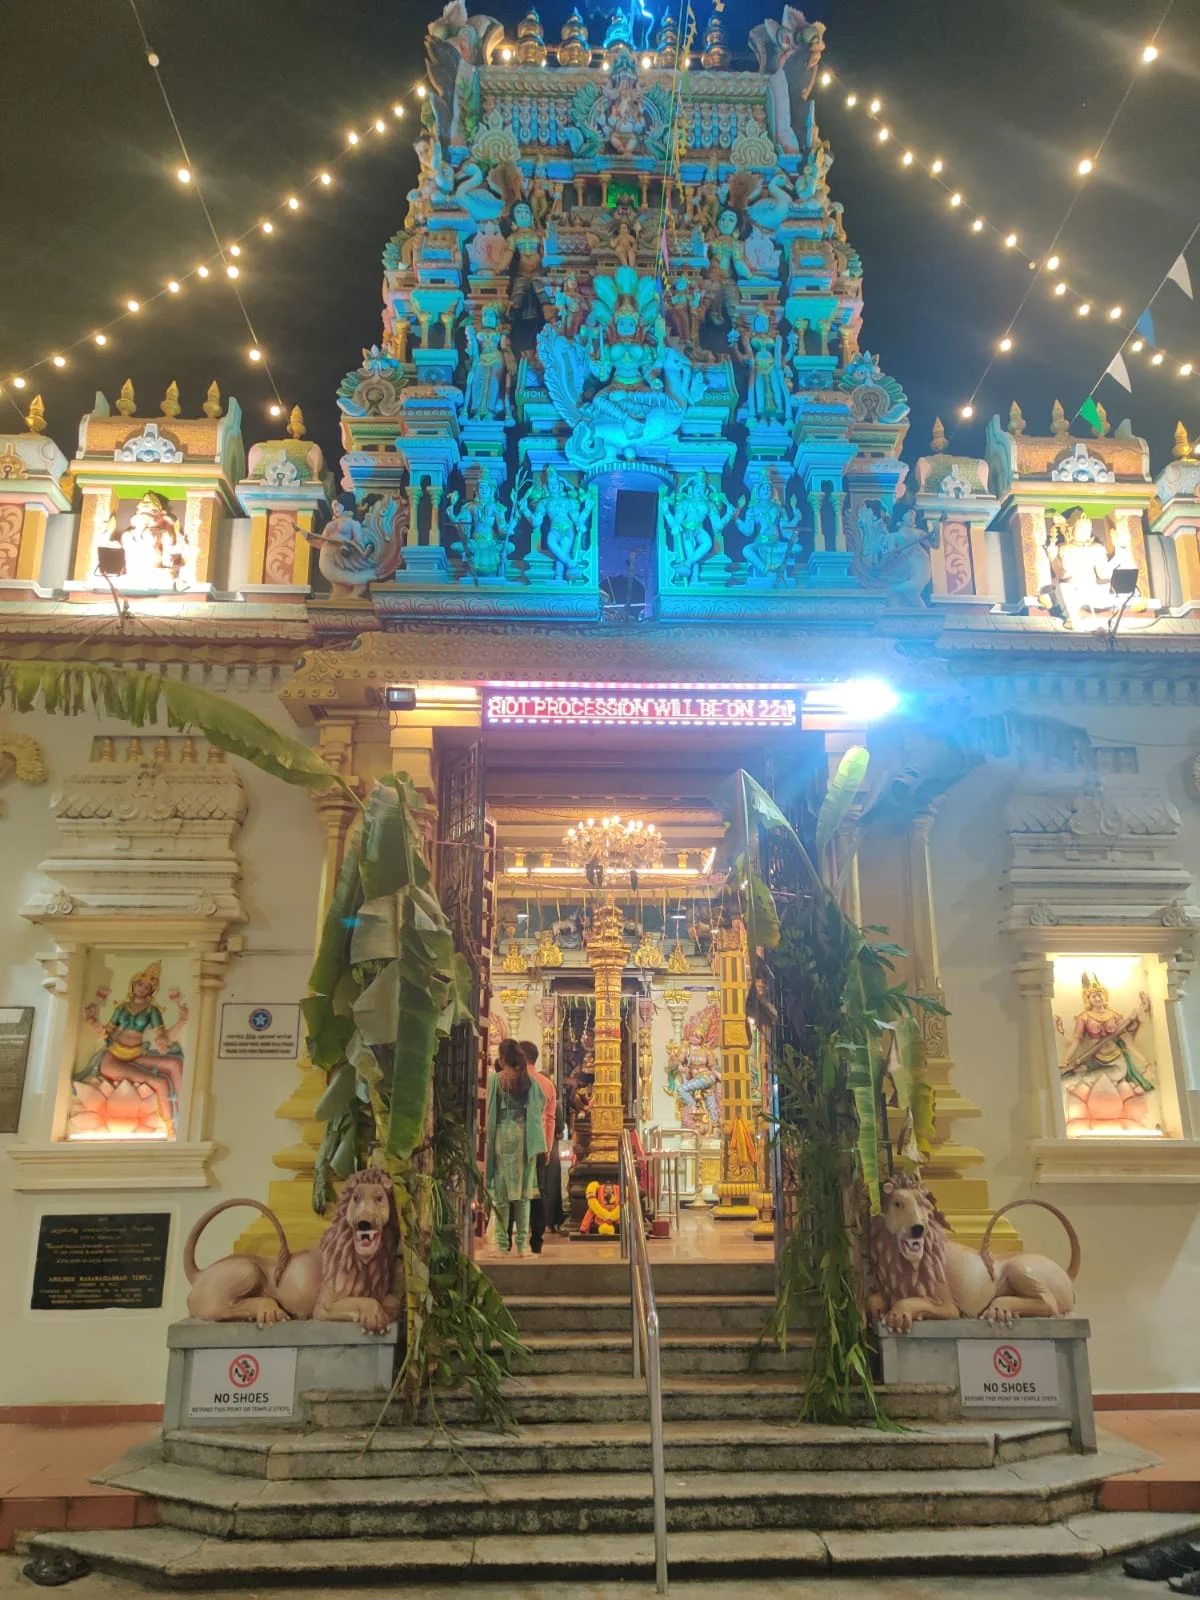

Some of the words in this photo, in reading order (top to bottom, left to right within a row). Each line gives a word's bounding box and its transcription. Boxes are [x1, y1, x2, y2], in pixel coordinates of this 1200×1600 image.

[534, 700, 648, 716] PROCESSION
[654, 701, 698, 717] WILL
[701, 702, 722, 717] BE
[727, 702, 753, 717] ON
[983, 1382, 998, 1392] NO
[1001, 1382, 1036, 1392] SHOES
[214, 1393, 229, 1403] NO
[232, 1392, 269, 1403] SHOES
